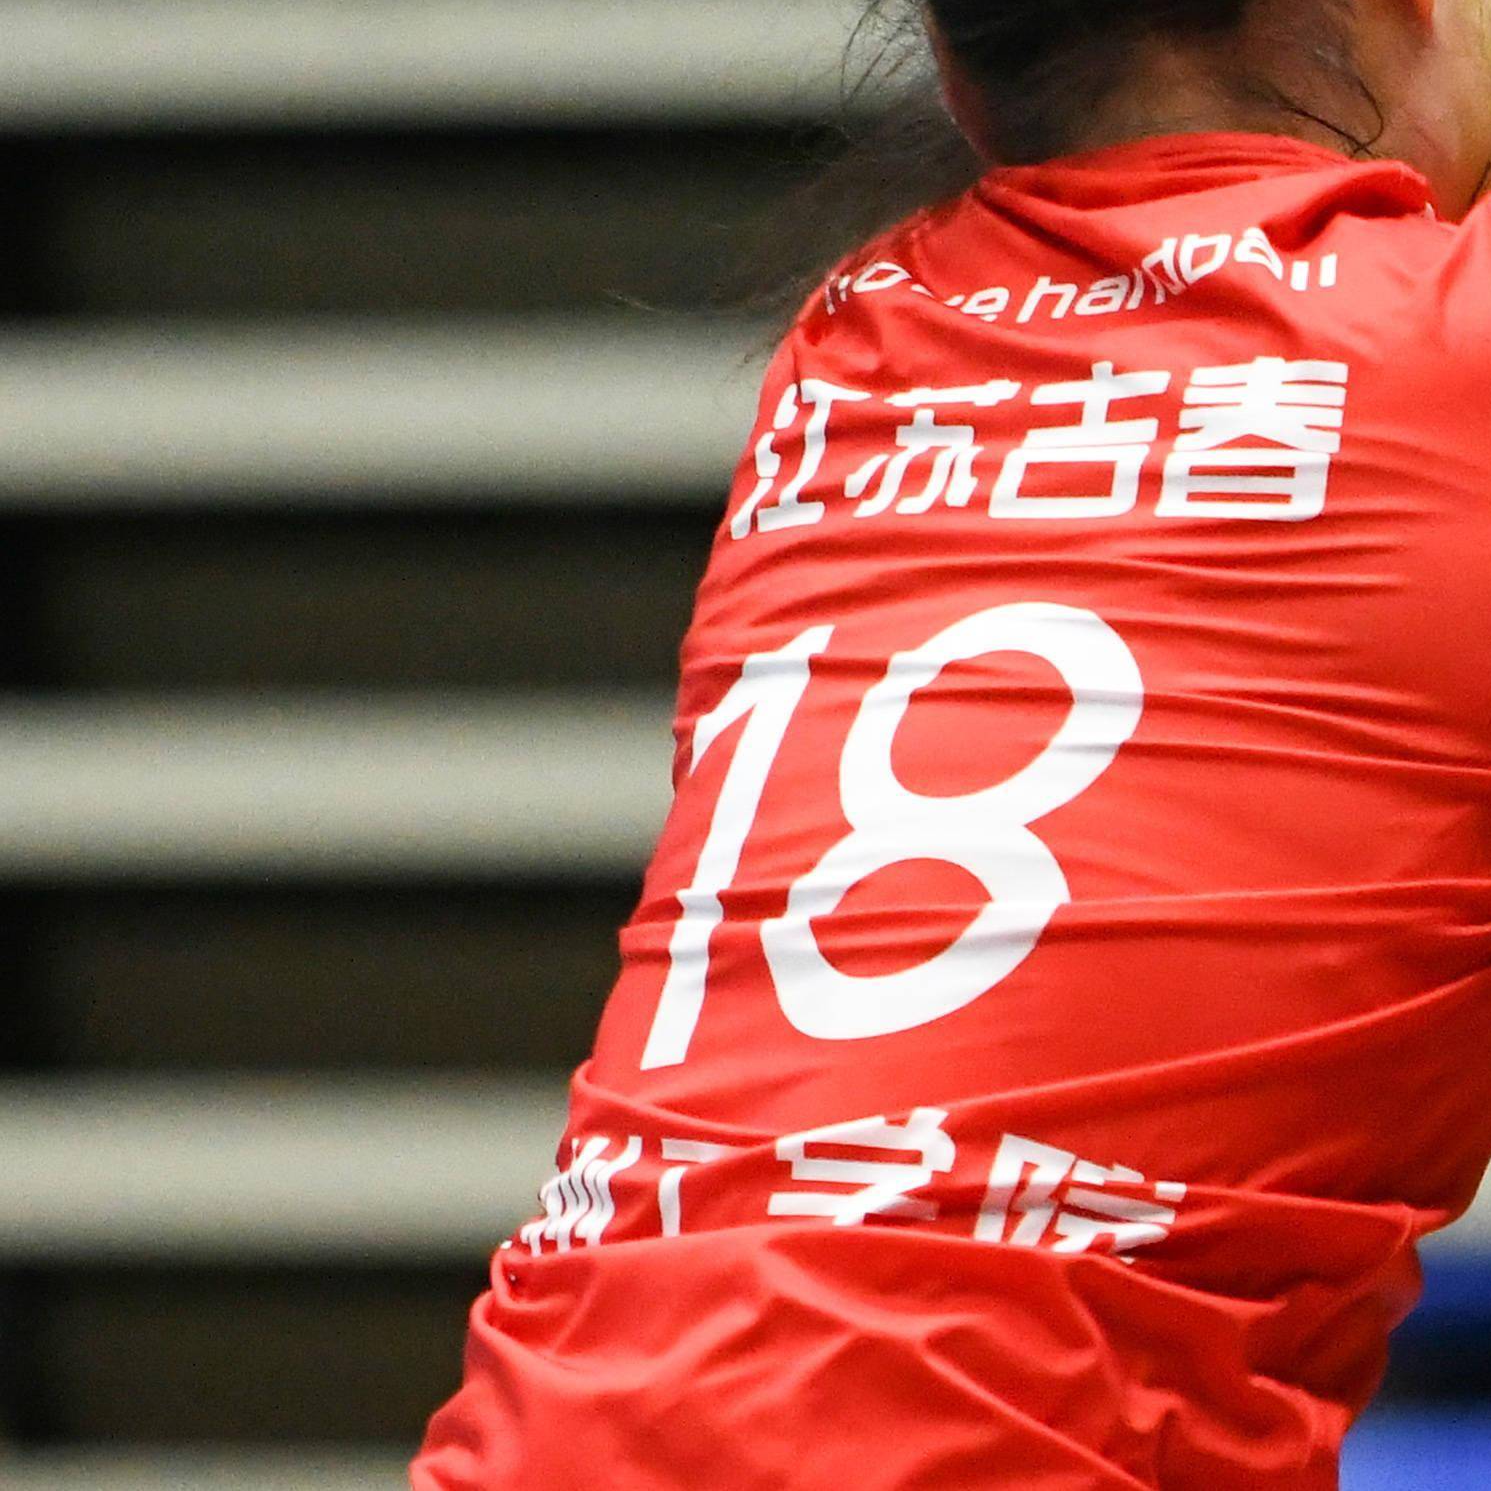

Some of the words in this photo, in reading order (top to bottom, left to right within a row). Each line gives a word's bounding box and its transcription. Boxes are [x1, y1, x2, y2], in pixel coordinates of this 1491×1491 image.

[730, 357, 1348, 540] 江苏吉春
[640, 602, 1144, 1070] 18
